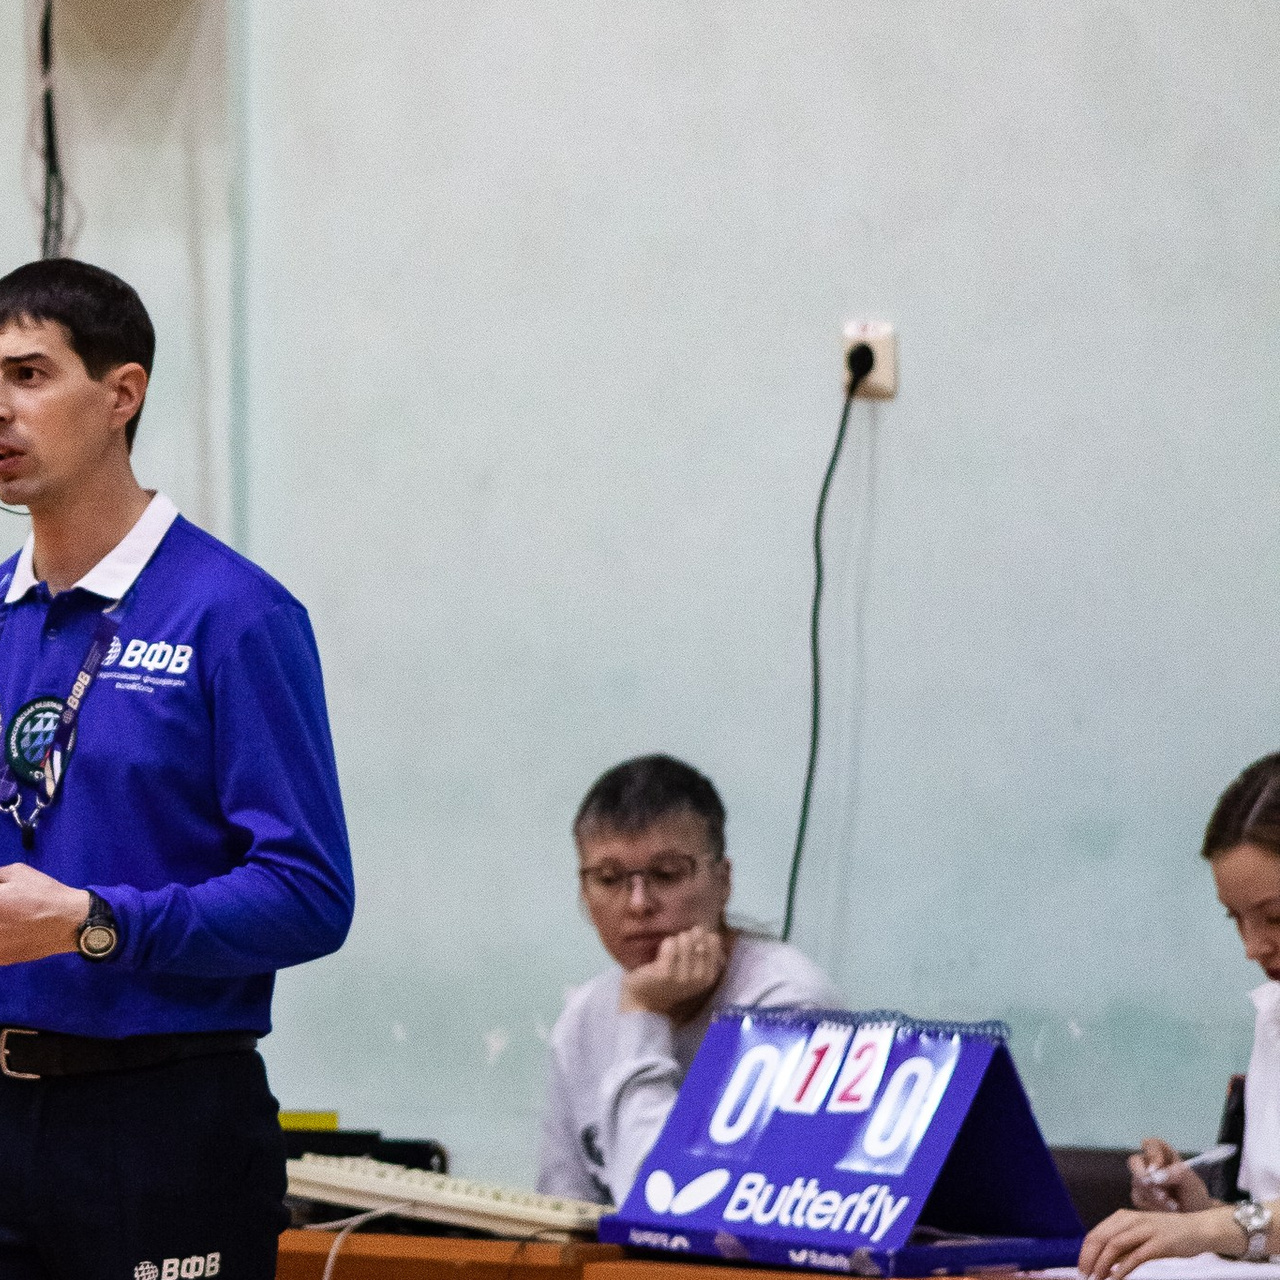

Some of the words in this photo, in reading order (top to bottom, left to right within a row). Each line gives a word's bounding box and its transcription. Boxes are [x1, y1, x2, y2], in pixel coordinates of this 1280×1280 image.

[119, 638, 194, 674] ВФВ
[66, 670, 91, 711] ВФВ
[709, 1043, 781, 1145] 0
[795, 1042, 830, 1104] 1
[837, 1041, 877, 1104] 2
[862, 1055, 933, 1158] 0
[722, 1172, 910, 1244] Butterfly
